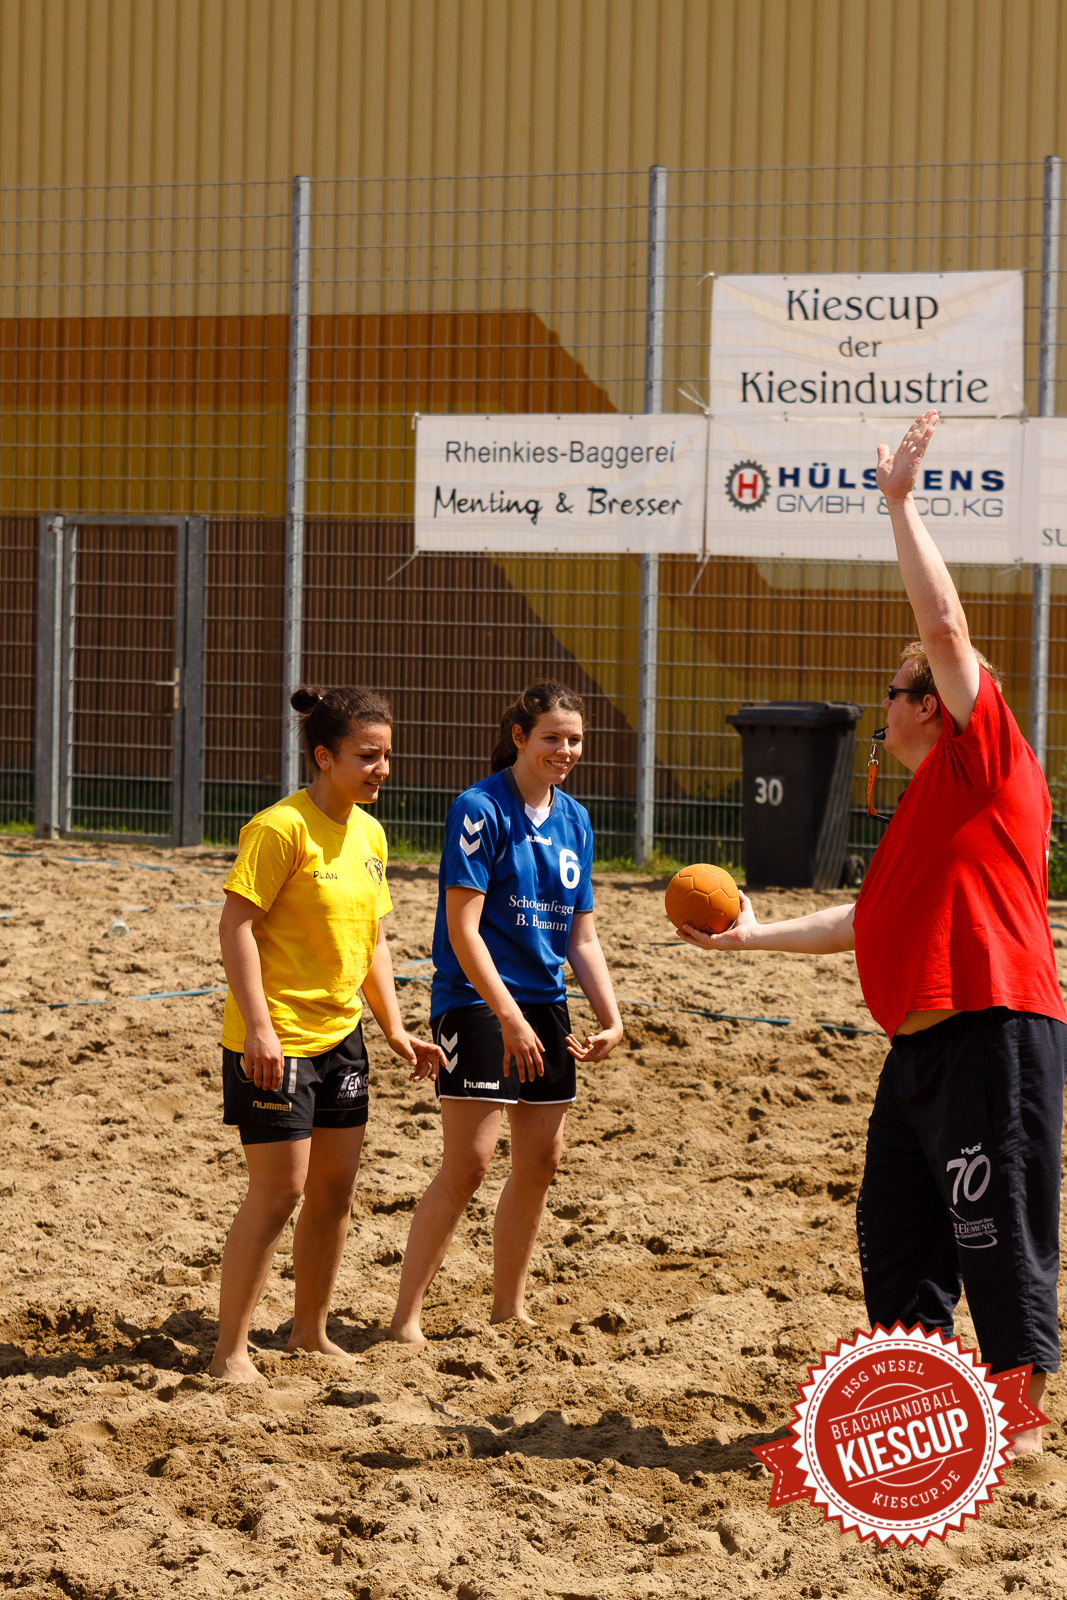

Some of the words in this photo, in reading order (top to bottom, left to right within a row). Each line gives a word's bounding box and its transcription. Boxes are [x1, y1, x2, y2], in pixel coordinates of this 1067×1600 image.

[787, 288, 939, 329] Kiescup
[838, 336, 882, 358] der
[740, 369, 989, 404] Kiesindustrie
[445, 441, 676, 469] Rheinkies-Baggerei
[737, 472, 759, 500] H
[778, 462, 1005, 492] HÜLSENS
[433, 485, 543, 526] Menting
[555, 492, 574, 515] &
[587, 486, 683, 517] Bresser
[776, 494, 865, 515] GMBH
[755, 777, 784, 807] 30
[559, 848, 581, 890] 6
[516, 913, 529, 927] B.
[463, 1078, 500, 1091] hummel
[946, 1154, 992, 1206] 70
